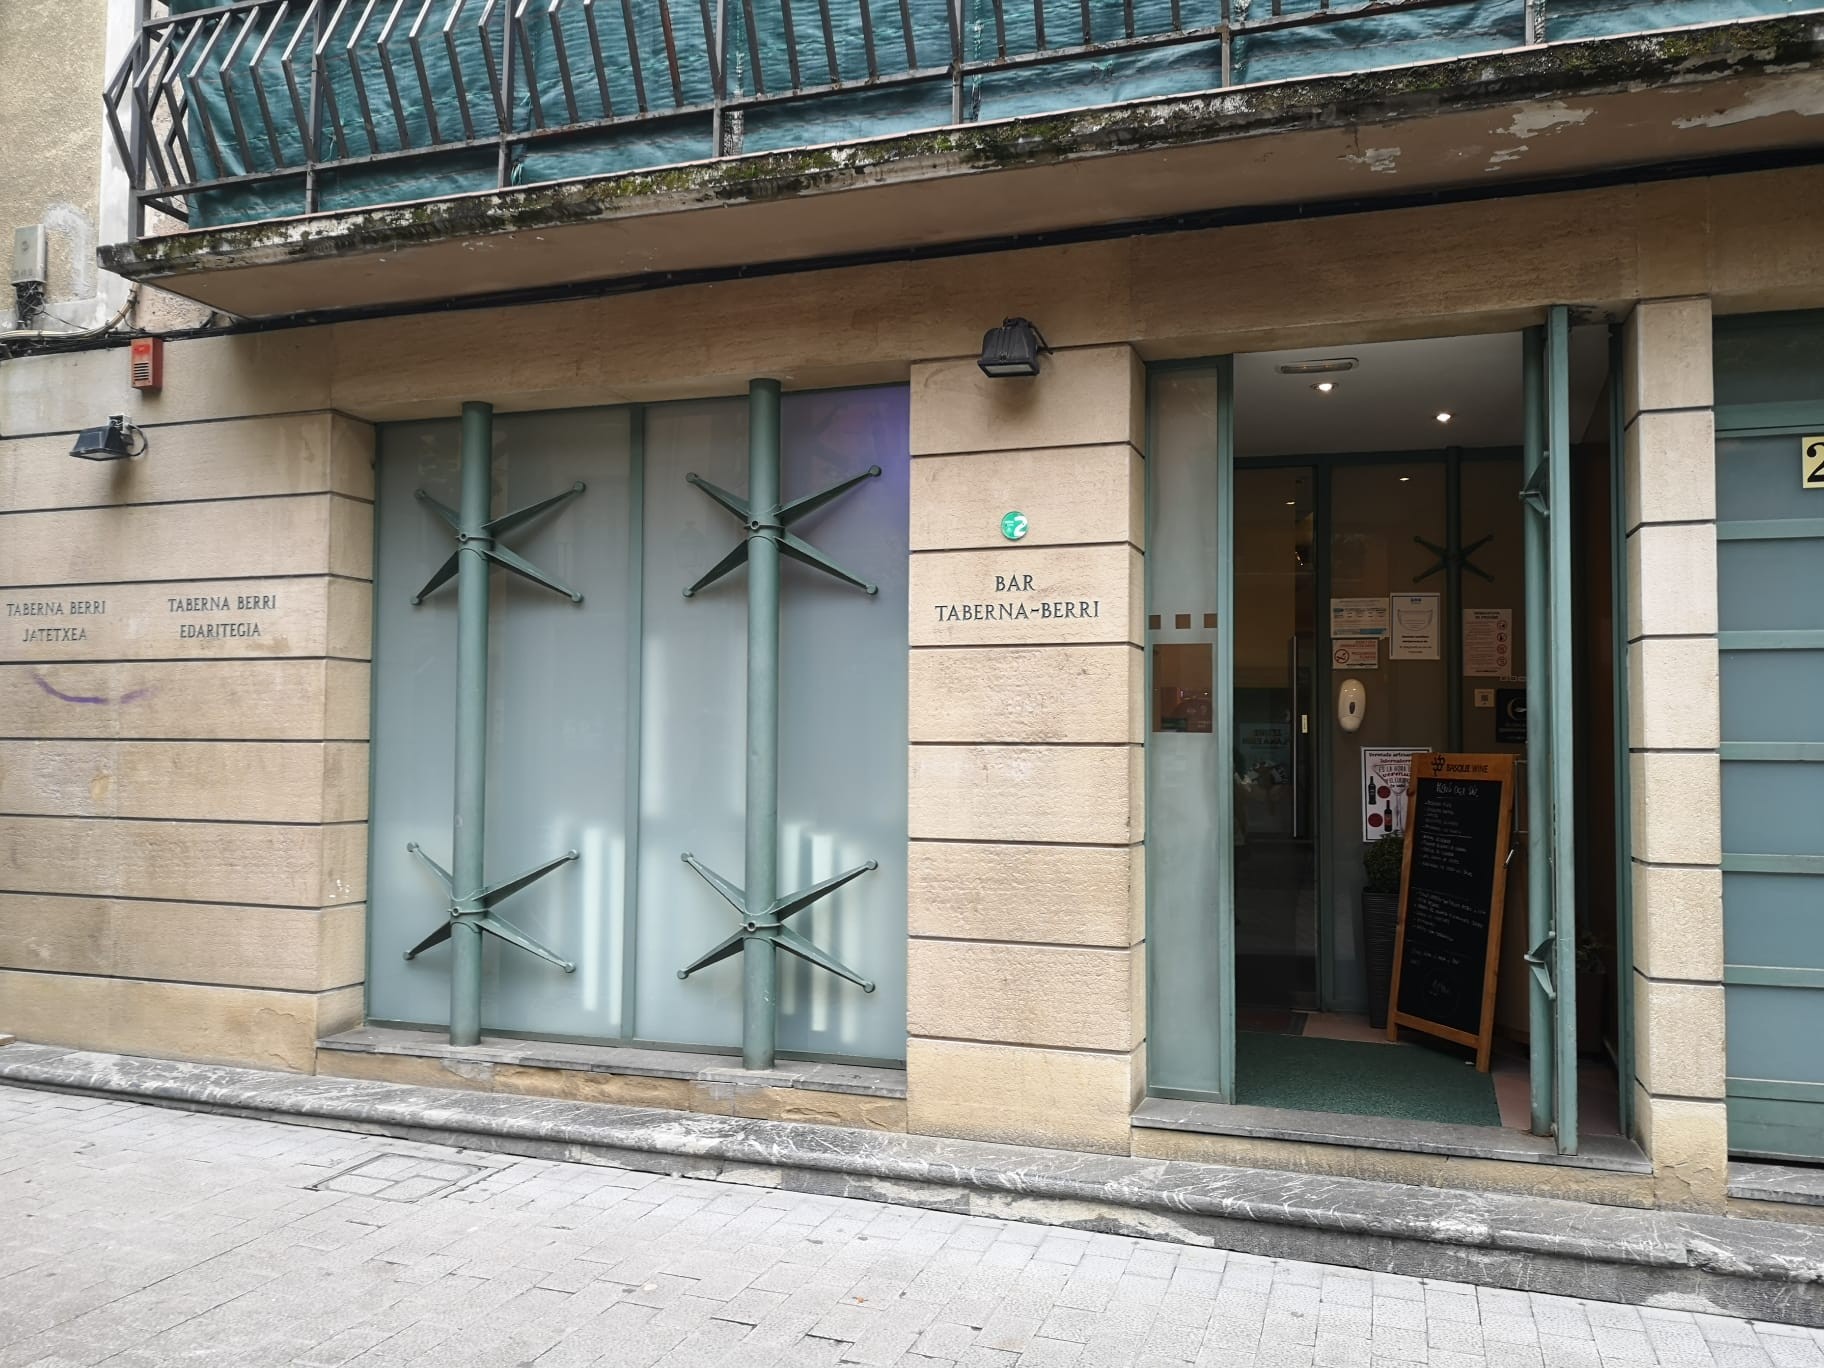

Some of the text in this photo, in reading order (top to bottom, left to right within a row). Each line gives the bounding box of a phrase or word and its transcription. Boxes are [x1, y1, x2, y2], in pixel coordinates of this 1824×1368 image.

[995, 574, 1035, 592] BAR
[6, 600, 106, 617] TABERNA BERRI
[168, 594, 277, 613] TABERNA BERRI
[935, 601, 1100, 621] TABERNA-BERRI
[22, 627, 88, 643] JATETXEA
[180, 622, 262, 639] EDARITEGIA
[1446, 763, 1489, 774] BASQUE WINE
